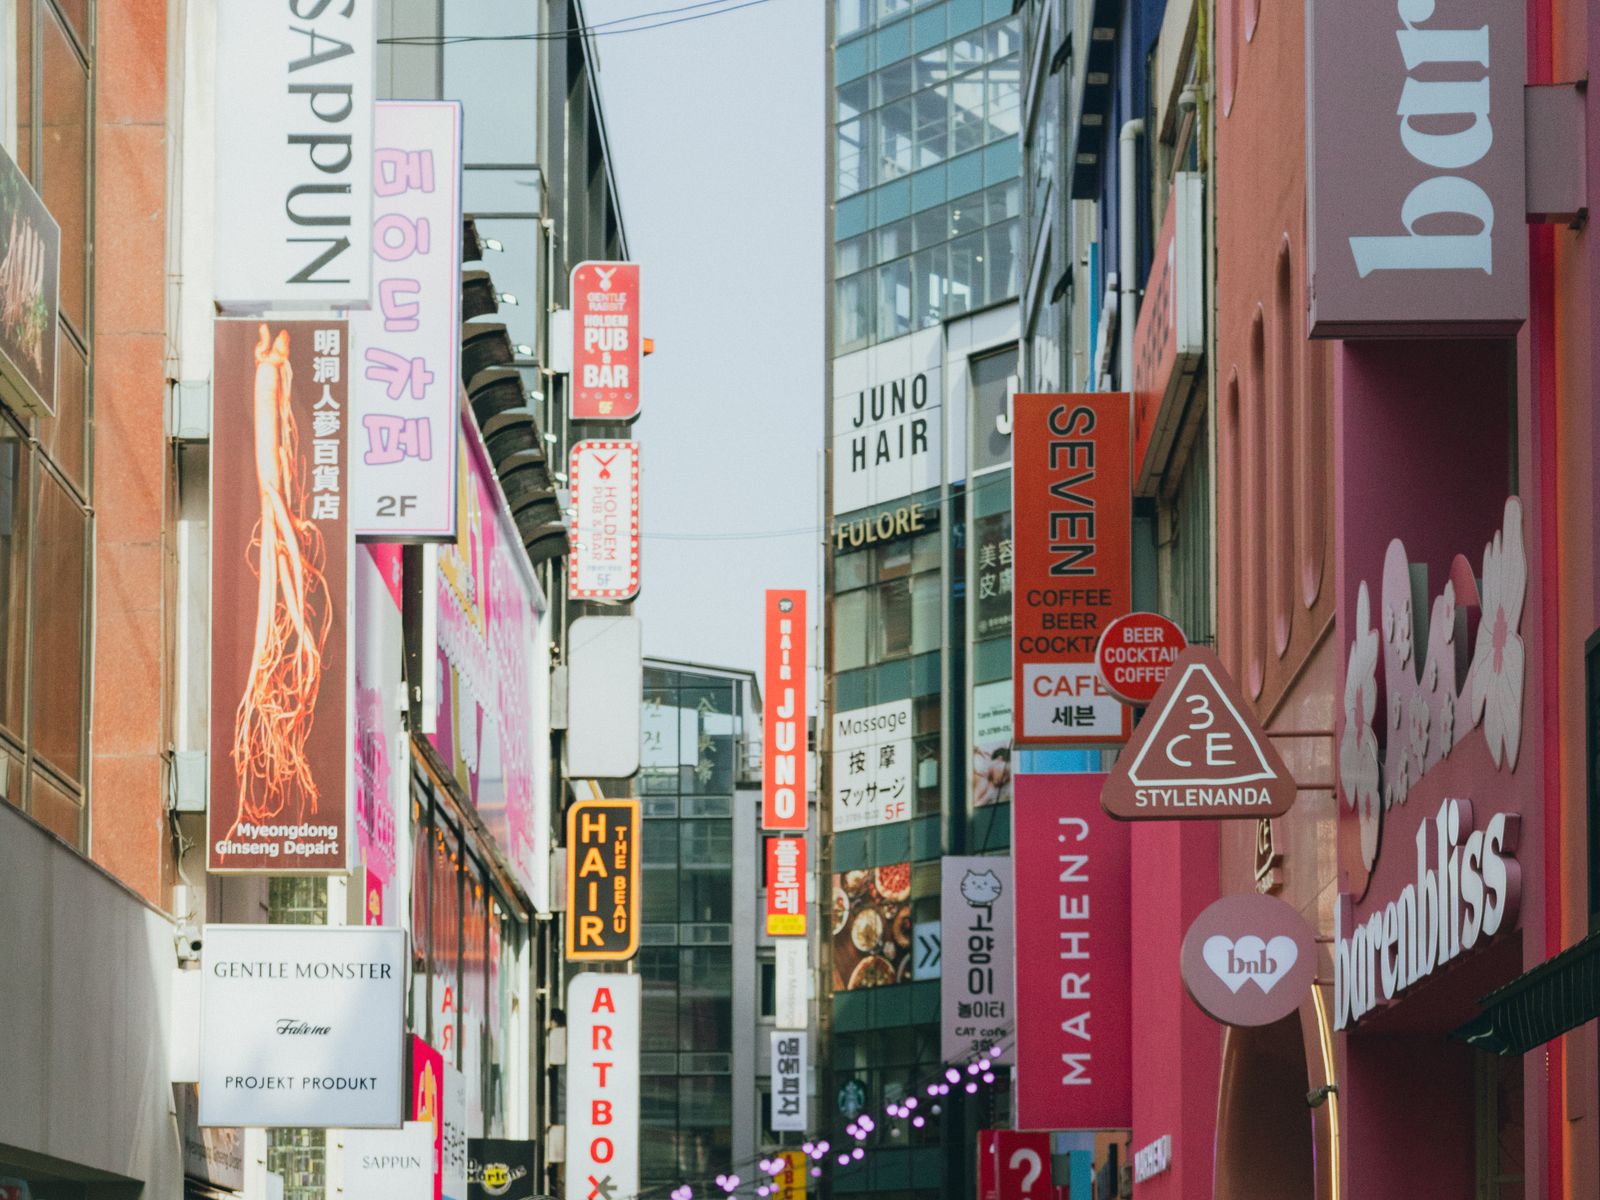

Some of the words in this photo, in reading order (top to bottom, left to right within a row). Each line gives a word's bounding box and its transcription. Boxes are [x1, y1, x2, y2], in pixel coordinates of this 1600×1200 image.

[286, 0, 355, 284] SAPPUN
[584, 314, 629, 327] HOLDEM
[584, 328, 629, 351] PUB
[583, 364, 629, 388] BAR
[853, 373, 928, 428] JUNO
[852, 418, 928, 473] HAIR
[1047, 404, 1096, 577] SEVEN
[376, 495, 417, 517] 2F
[604, 486, 617, 561] HOLDEM
[837, 503, 925, 551] FULORE
[1027, 589, 1112, 607] COFFEE
[1042, 613, 1097, 630] BEER
[1124, 627, 1163, 643] BEER
[780, 619, 792, 680] HAIR
[839, 711, 907, 737] Massage
[1052, 705, 1096, 727] 세븐
[775, 687, 796, 819] JUNO
[840, 777, 905, 807] マッサージ
[1135, 786, 1271, 807] STYLENANDA
[885, 802, 905, 820] 5F
[237, 823, 338, 840] Myeongdong
[215, 840, 279, 857] Ginseng
[284, 840, 338, 857] Depart
[614, 826, 627, 869] THE
[579, 813, 608, 947] HAIR
[613, 876, 627, 933] BEAU
[1334, 797, 1508, 1032] barenbliss
[968, 903, 995, 995] 고양이
[214, 961, 289, 979] GENTLE
[296, 962, 391, 979] MONSTER
[1227, 950, 1278, 975] bnb
[955, 1027, 976, 1037] CAT
[225, 1076, 294, 1090] PROJEKT
[302, 1076, 378, 1090] PRODUKT
[777, 1038, 800, 1116] 명동피자
[588, 987, 618, 1200] ARTBOX
[363, 1156, 422, 1169] SAPPUN
